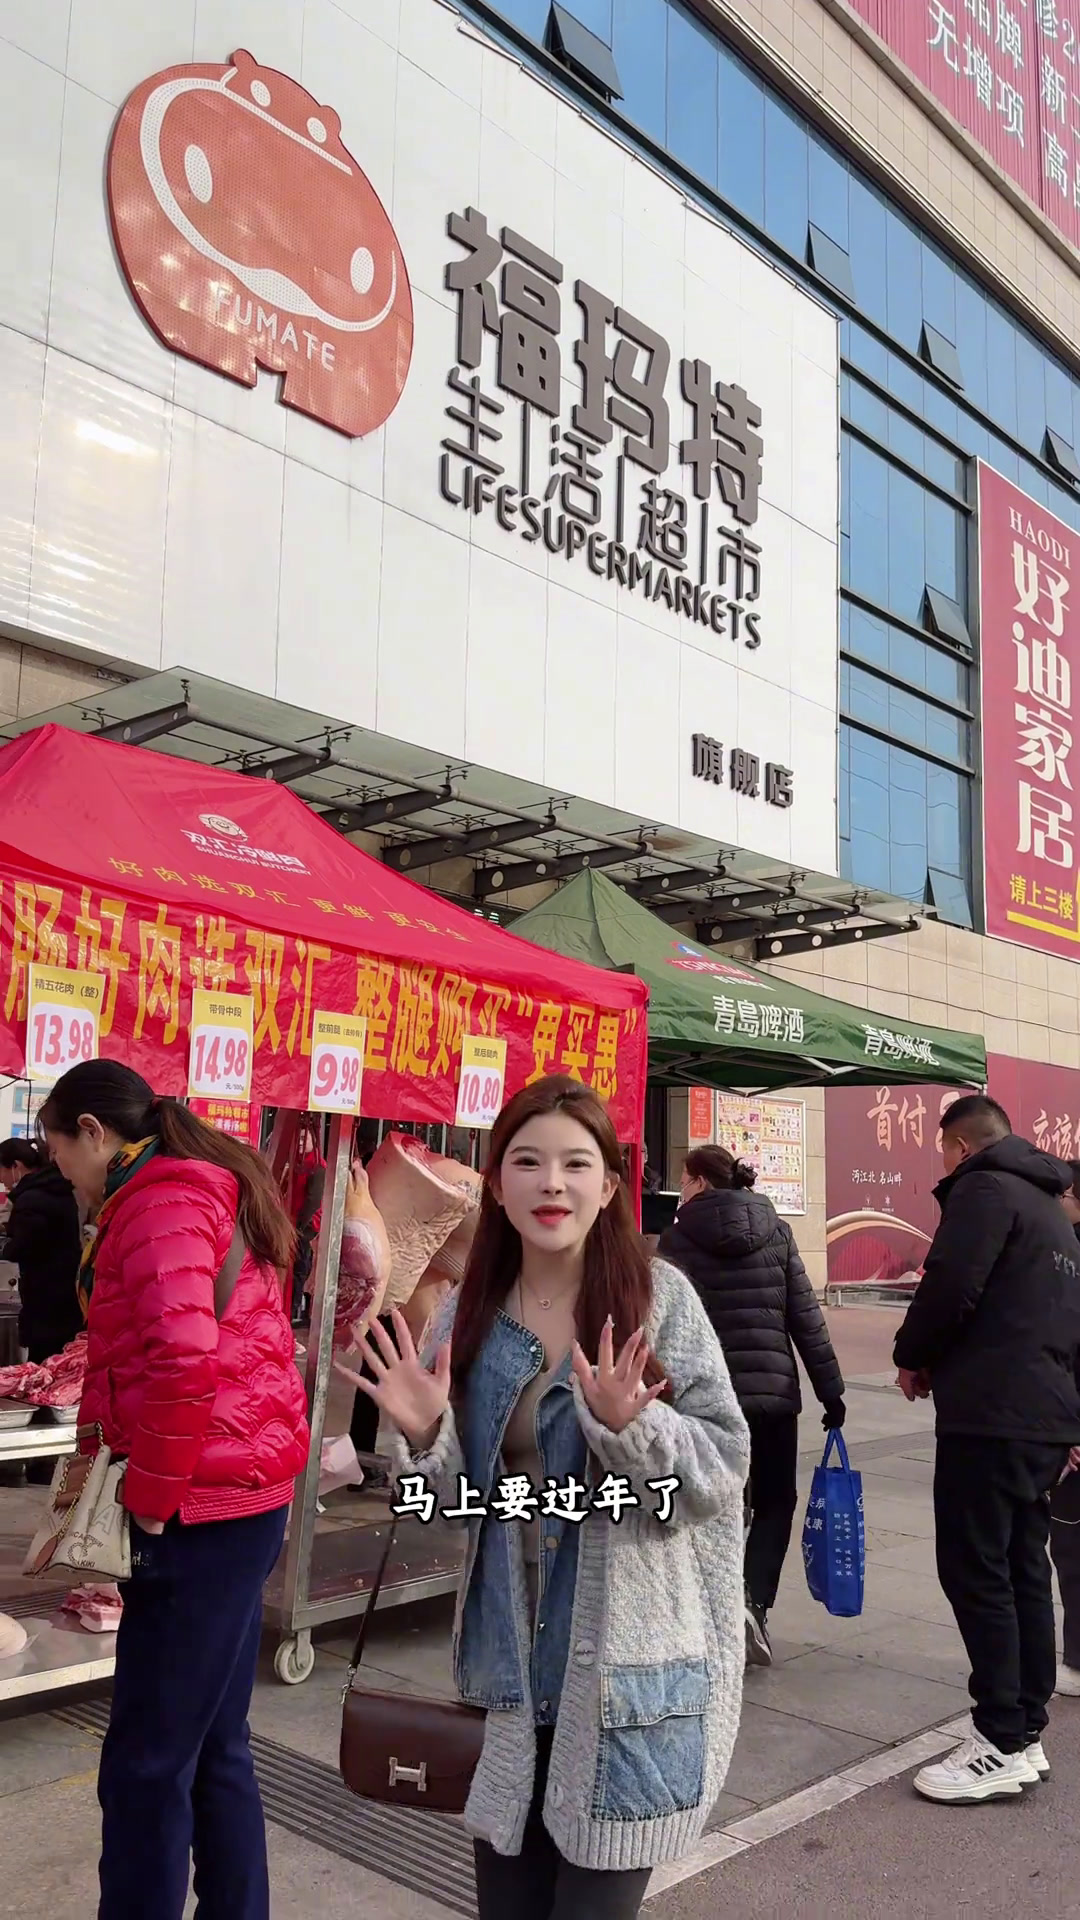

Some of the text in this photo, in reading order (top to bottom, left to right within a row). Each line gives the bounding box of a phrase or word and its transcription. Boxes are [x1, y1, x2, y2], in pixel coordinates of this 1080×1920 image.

[927, 0, 1026, 148] 无增项
[214, 281, 336, 372] FUMATE
[446, 206, 763, 526] 福玛特
[1009, 506, 1072, 569] HAODI
[1010, 539, 1075, 869] 好迪家居
[691, 732, 794, 809] 旗舰店
[108, 856, 302, 907] 好肉选双汇
[1009, 873, 1074, 921] 请上三楼
[209, 1003, 242, 1018] 带骨中段
[34, 1013, 94, 1065] 13.98
[194, 1034, 248, 1083] 14.98
[314, 1053, 359, 1097] 9.98
[461, 1073, 500, 1114] 10.80
